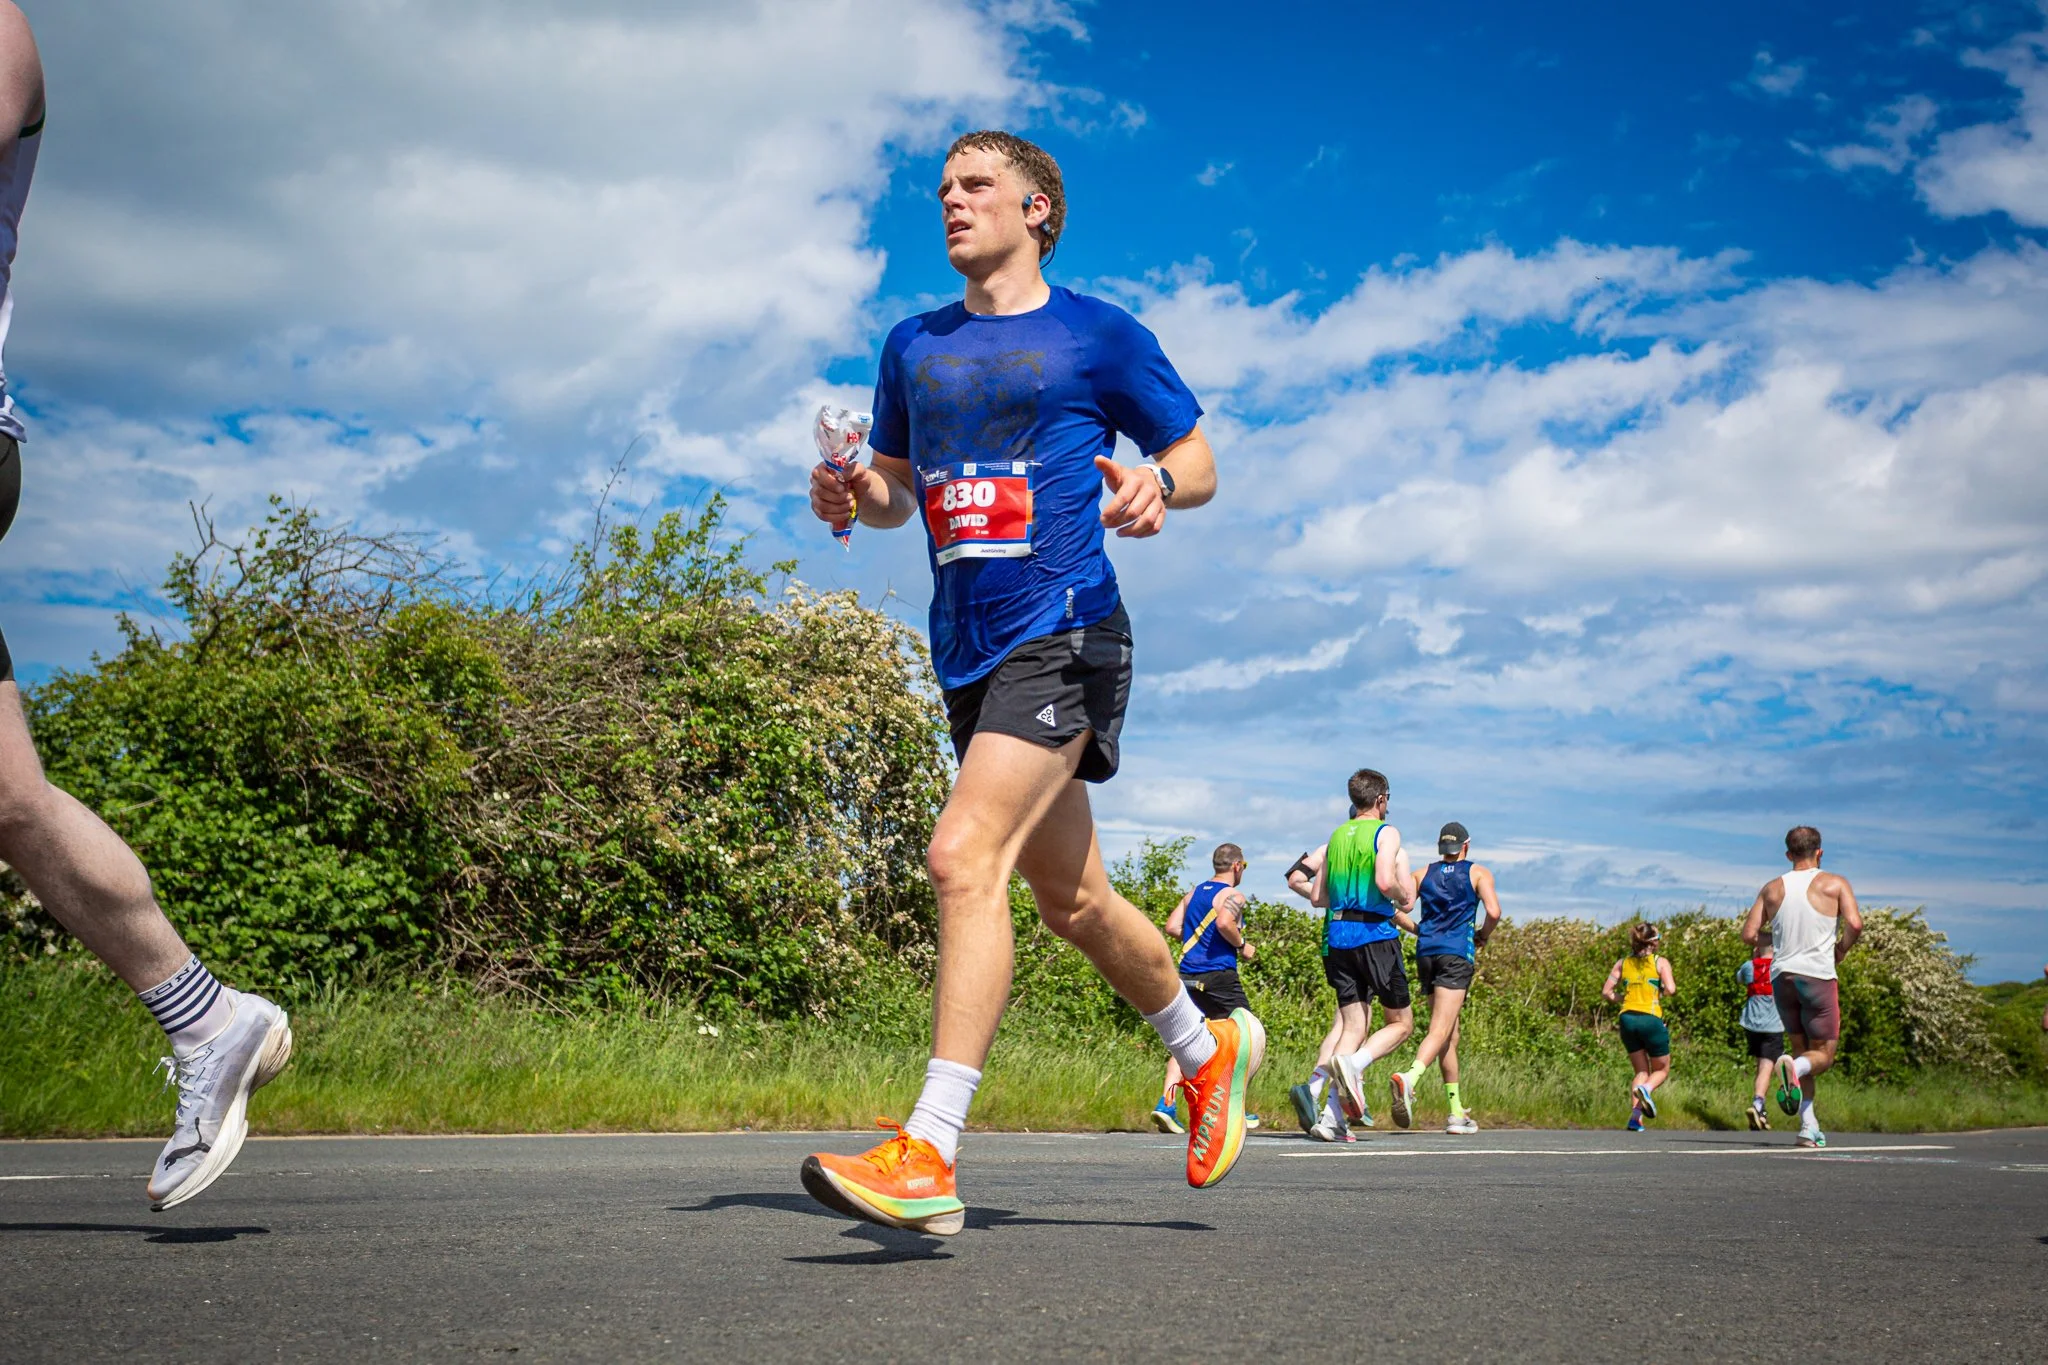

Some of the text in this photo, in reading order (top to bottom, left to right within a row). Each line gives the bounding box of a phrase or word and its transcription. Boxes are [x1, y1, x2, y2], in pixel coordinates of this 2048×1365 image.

[942, 481, 996, 511] 830
[949, 514, 988, 530] DAVID
[1193, 1084, 1225, 1161] KIPRUN
